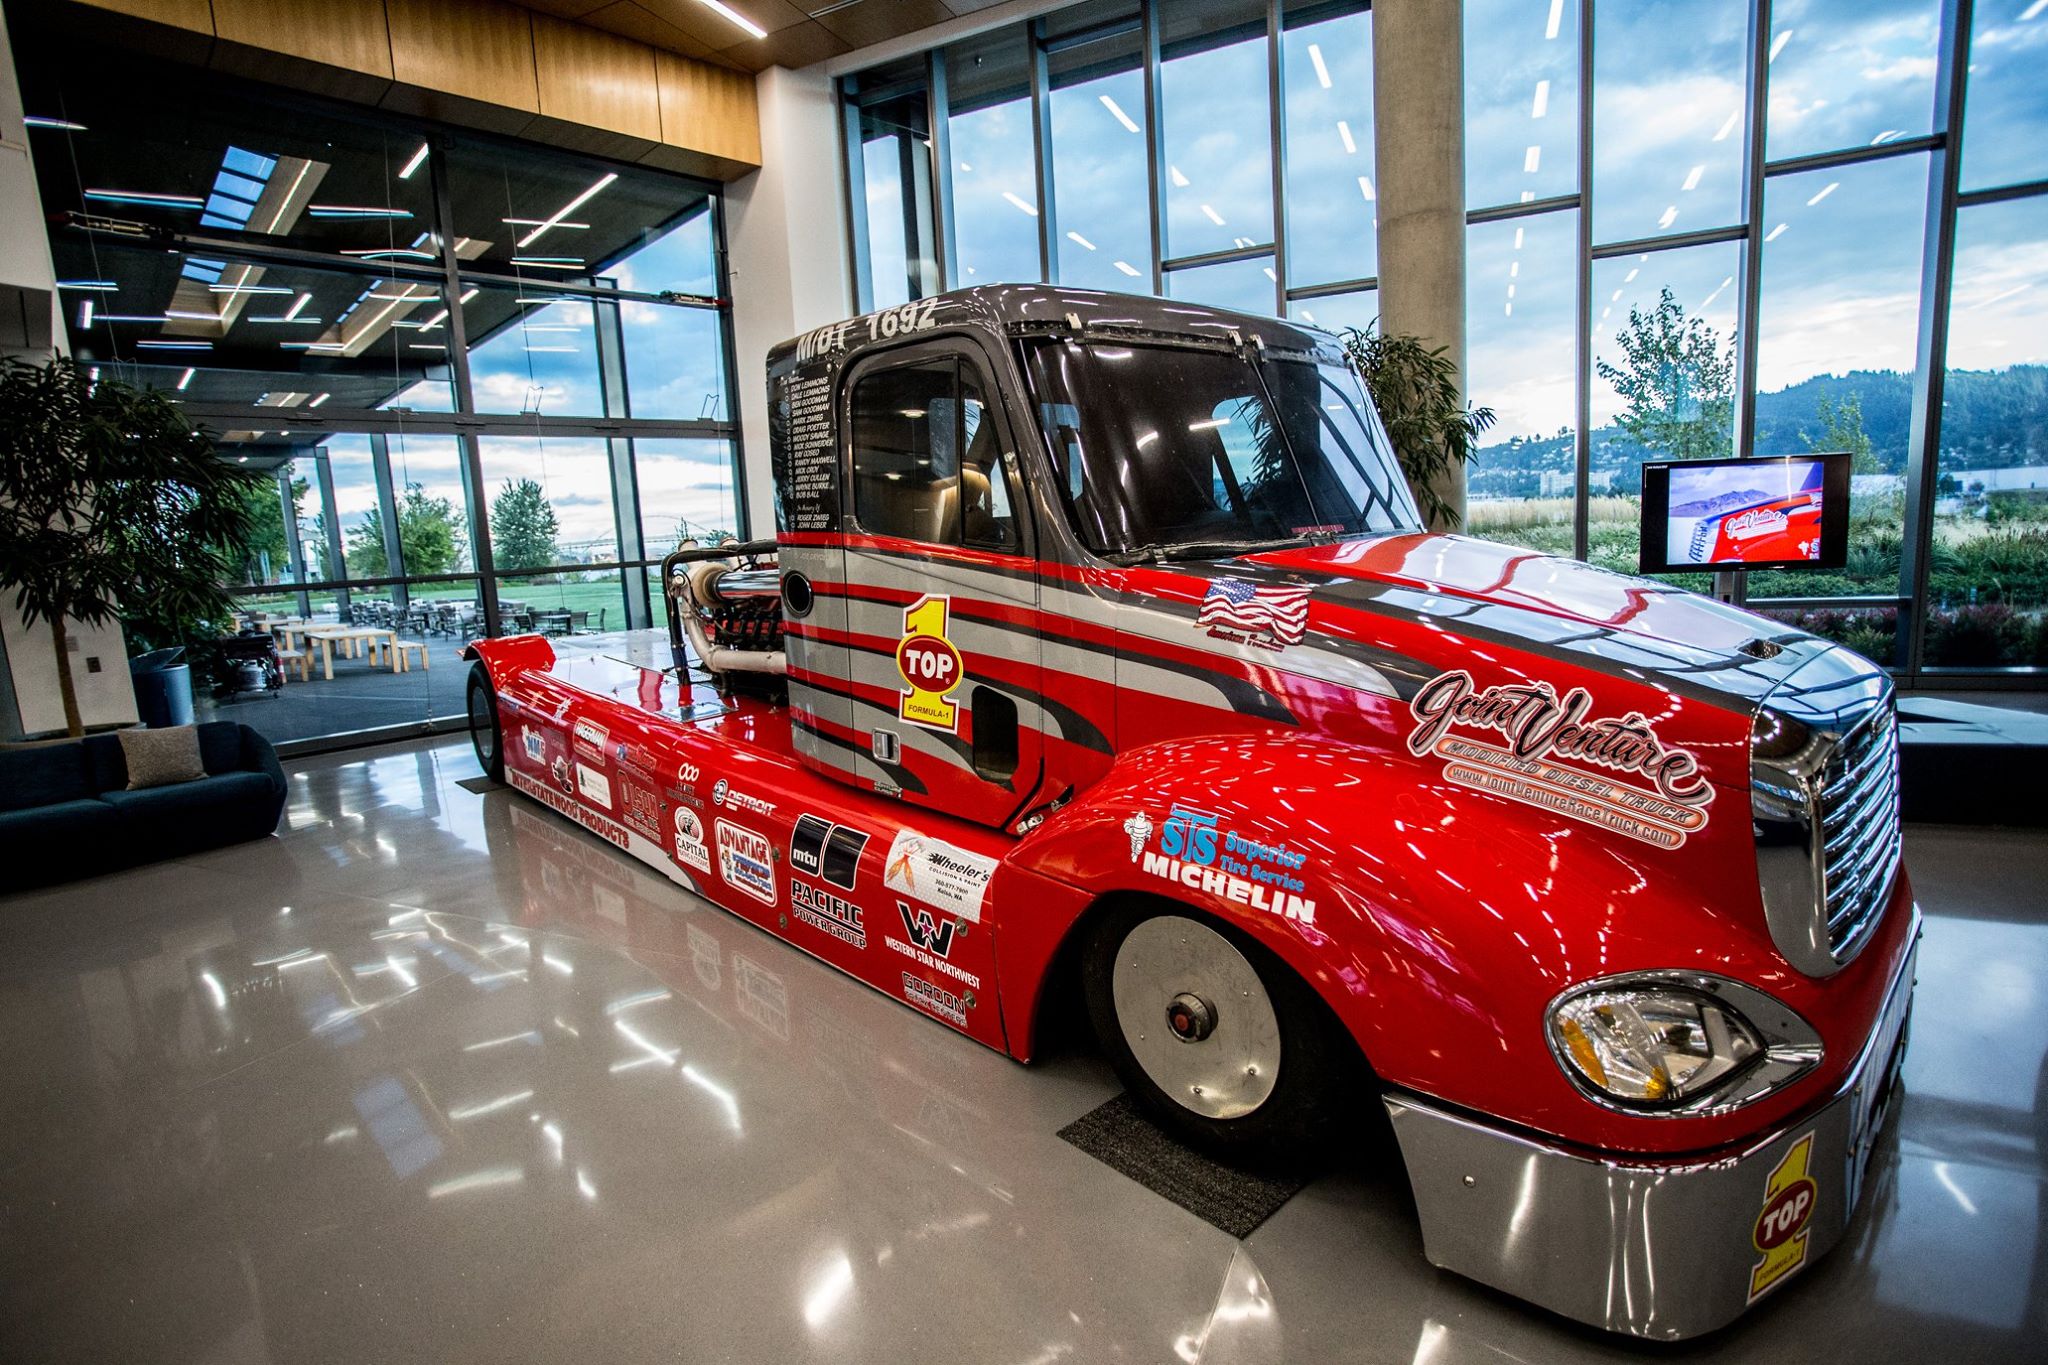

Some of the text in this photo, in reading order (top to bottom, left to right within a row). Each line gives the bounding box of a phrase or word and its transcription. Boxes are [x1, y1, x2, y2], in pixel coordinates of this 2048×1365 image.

[866, 297, 938, 341] 1692
[791, 385, 830, 400] DALE LEMMONS
[801, 376, 829, 389] LEMMONS
[802, 394, 829, 406] GOODMAN
[802, 403, 830, 414] GOODMAN
[804, 439, 834, 449] SCHNEIDER
[810, 431, 829, 440] SAVAGE
[810, 455, 836, 465] MAXWELL
[810, 473, 830, 481] CULLEN
[796, 491, 806, 499] BOB
[905, 649, 953, 679] TOP
[908, 704, 949, 719] FORMULA-1
[1511, 685, 1713, 803] Venture
[1444, 741, 1694, 824] MODIFIED DIESEL TRUCK
[512, 771, 555, 807] INTERSTATE
[554, 796, 578, 819] WOOD
[579, 806, 630, 849] PRODUCTS
[727, 789, 777, 816] DETROIT
[1451, 766, 1673, 846] www.JointVentureRaceTruck.com
[676, 837, 708, 861] CAPITAL
[720, 823, 769, 866] ADVANTAGE
[1161, 803, 1219, 865] STS
[793, 848, 818, 868] mtu
[1225, 831, 1306, 870] Superior
[927, 852, 990, 882] Wheeler's
[929, 866, 957, 880] COLLISION
[964, 879, 981, 888] PAINT
[1219, 855, 1305, 892] Tire Service
[1143, 851, 1316, 924] MICHELIN
[791, 878, 863, 928] PACIFIC
[793, 906, 867, 950] POWER GROUP
[884, 935, 980, 989] WESTERN STAR NORTHWEST
[902, 971, 965, 1016] GORDON
[1763, 1189, 1810, 1242] TOP
